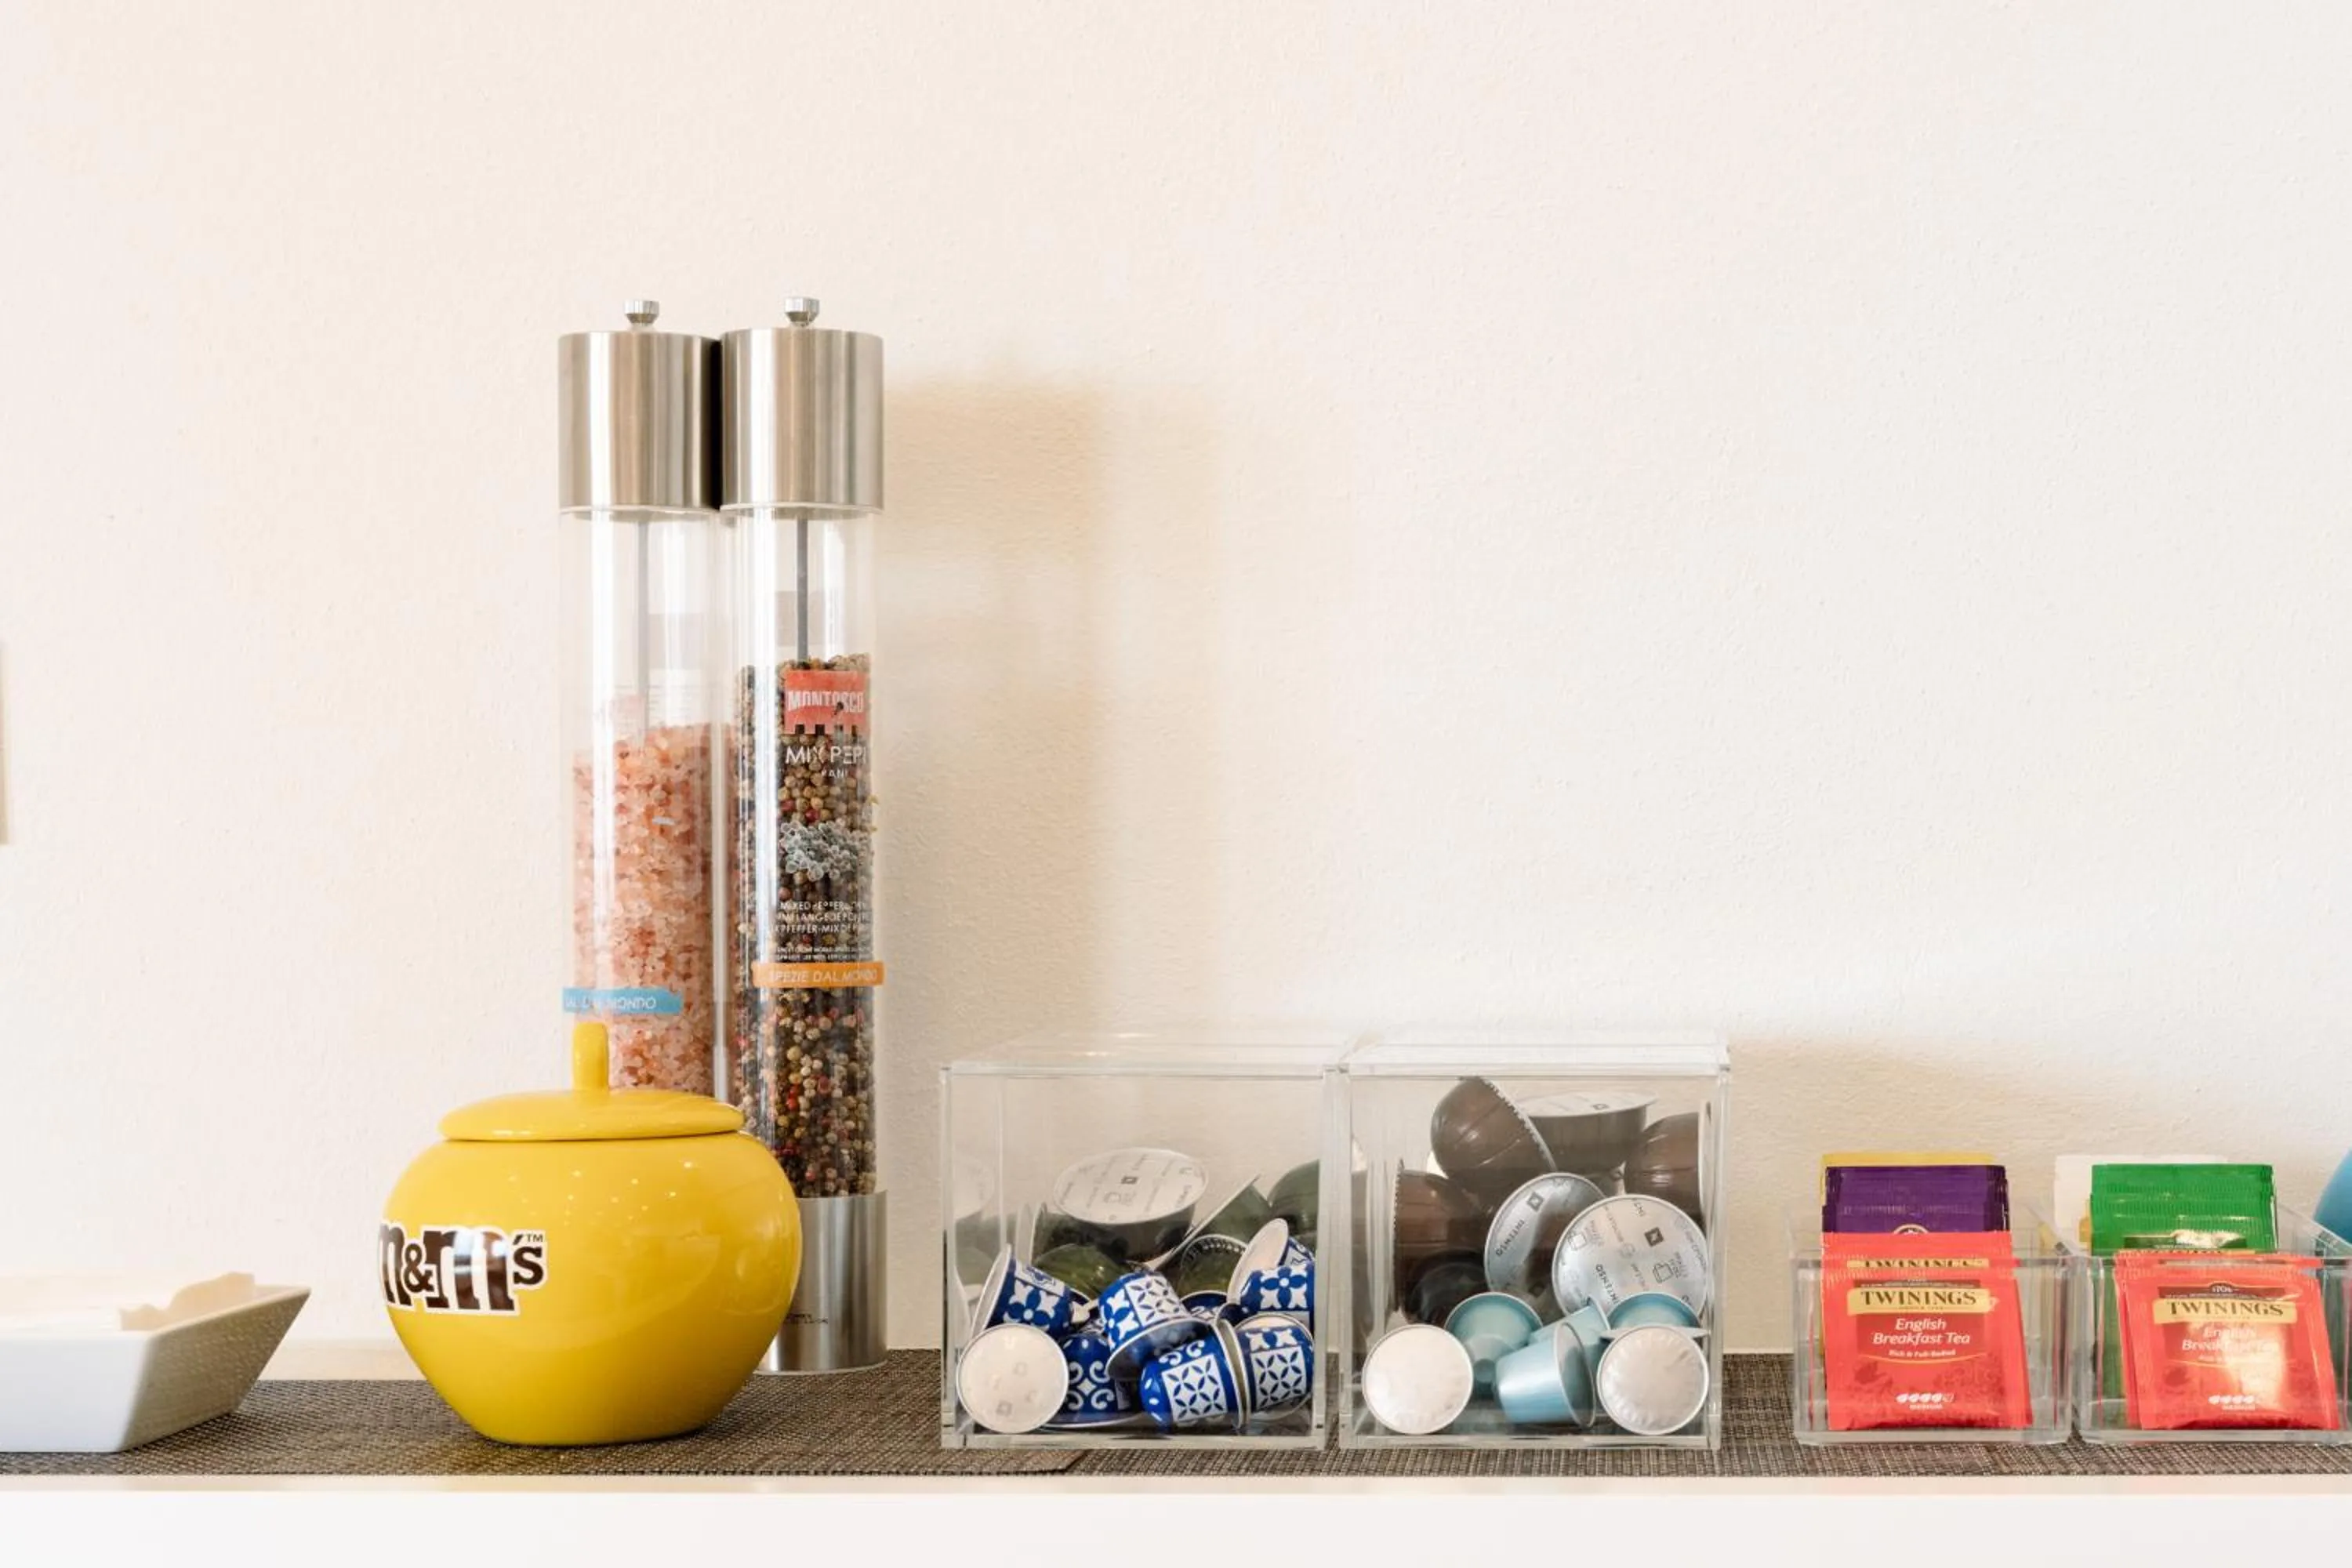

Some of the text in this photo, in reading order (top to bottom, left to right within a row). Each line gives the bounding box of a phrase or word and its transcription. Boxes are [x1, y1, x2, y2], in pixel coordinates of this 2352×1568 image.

[1860, 1290, 1976, 1305] TWININGS
[2167, 1301, 2284, 1316] TWININGS
[1894, 1318, 1947, 1332] English
[1873, 1332, 1970, 1346] Breakfast Tea
